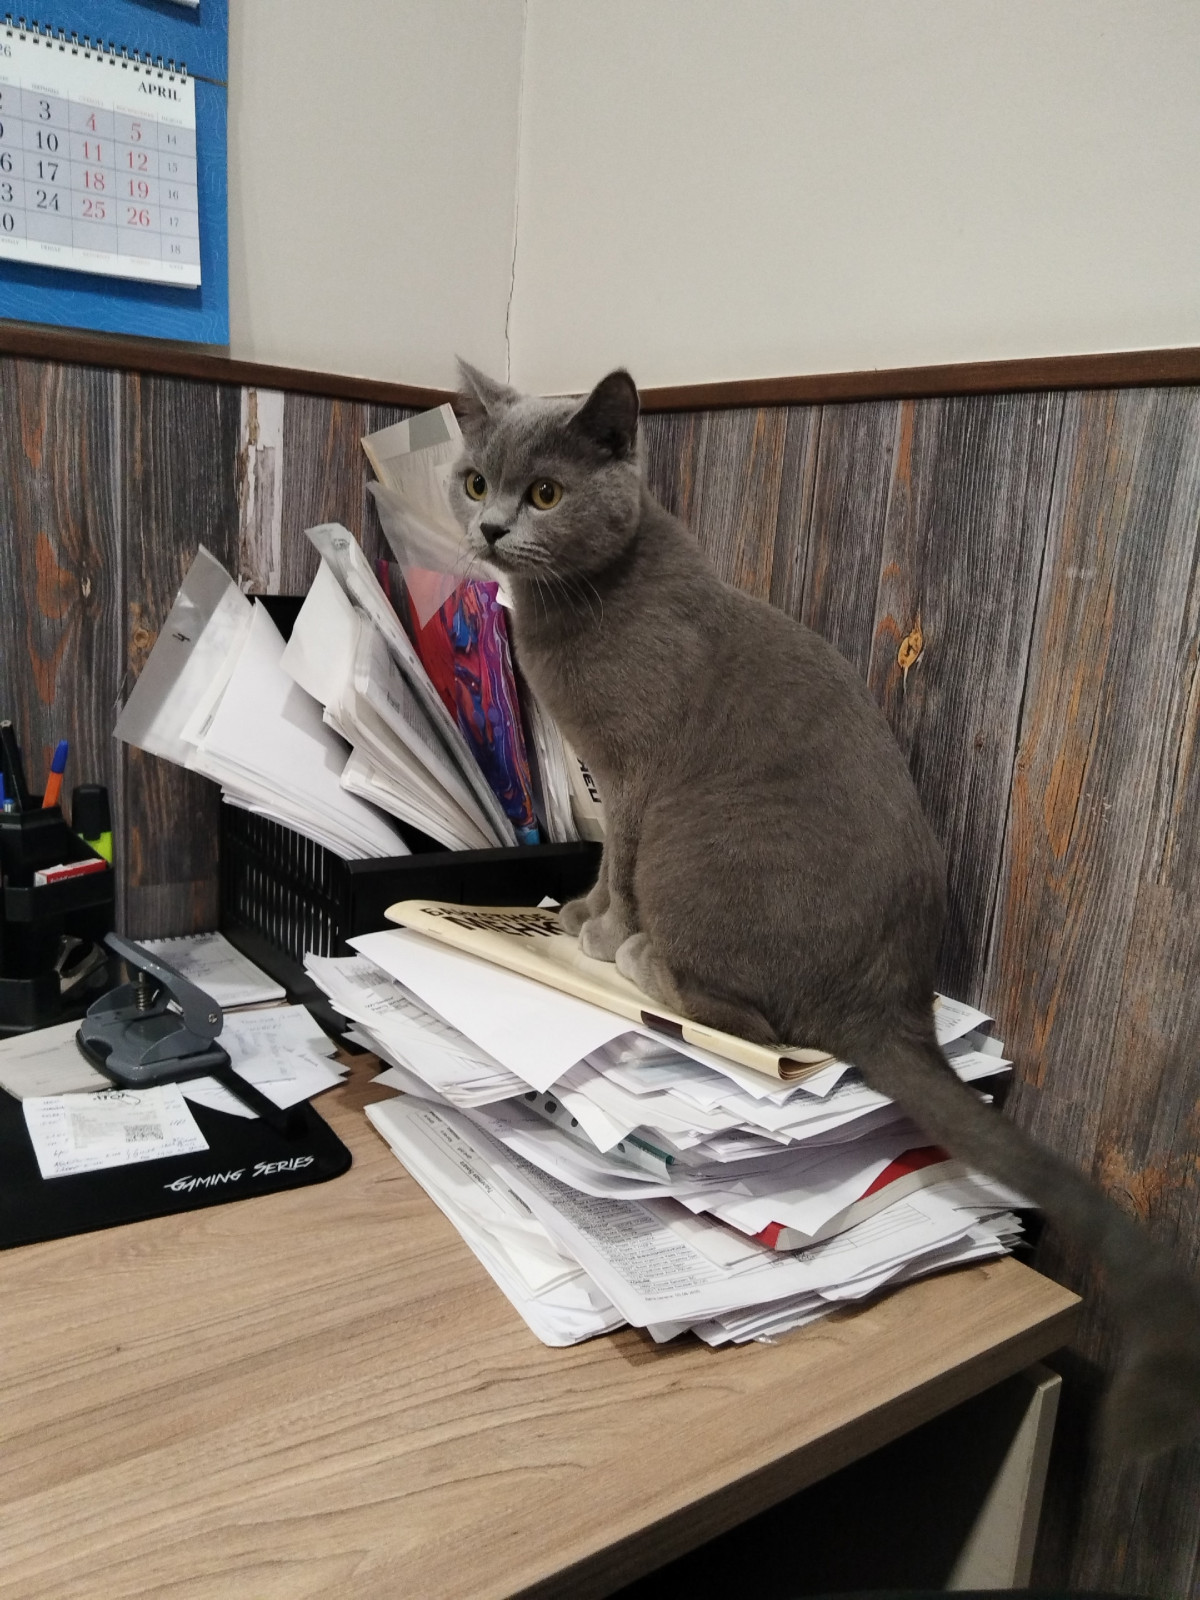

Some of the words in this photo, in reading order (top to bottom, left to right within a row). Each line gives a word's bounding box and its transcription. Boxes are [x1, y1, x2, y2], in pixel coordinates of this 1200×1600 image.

[138, 81, 182, 102] APRIL
[39, 100, 51, 120] 3
[86, 112, 97, 132] 4
[130, 122, 142, 142] 5
[166, 133, 178, 145] 14
[37, 130, 59, 153] 10
[83, 141, 102, 162] 11
[126, 151, 149, 172] 12
[37, 160, 59, 182] 17
[83, 170, 105, 191] 18
[127, 179, 149, 199] 19
[36, 189, 59, 211] 24
[82, 199, 106, 220] 25
[126, 206, 150, 227] 26
[163, 1168, 247, 1193] GAMING
[252, 1154, 315, 1178] SERIES
